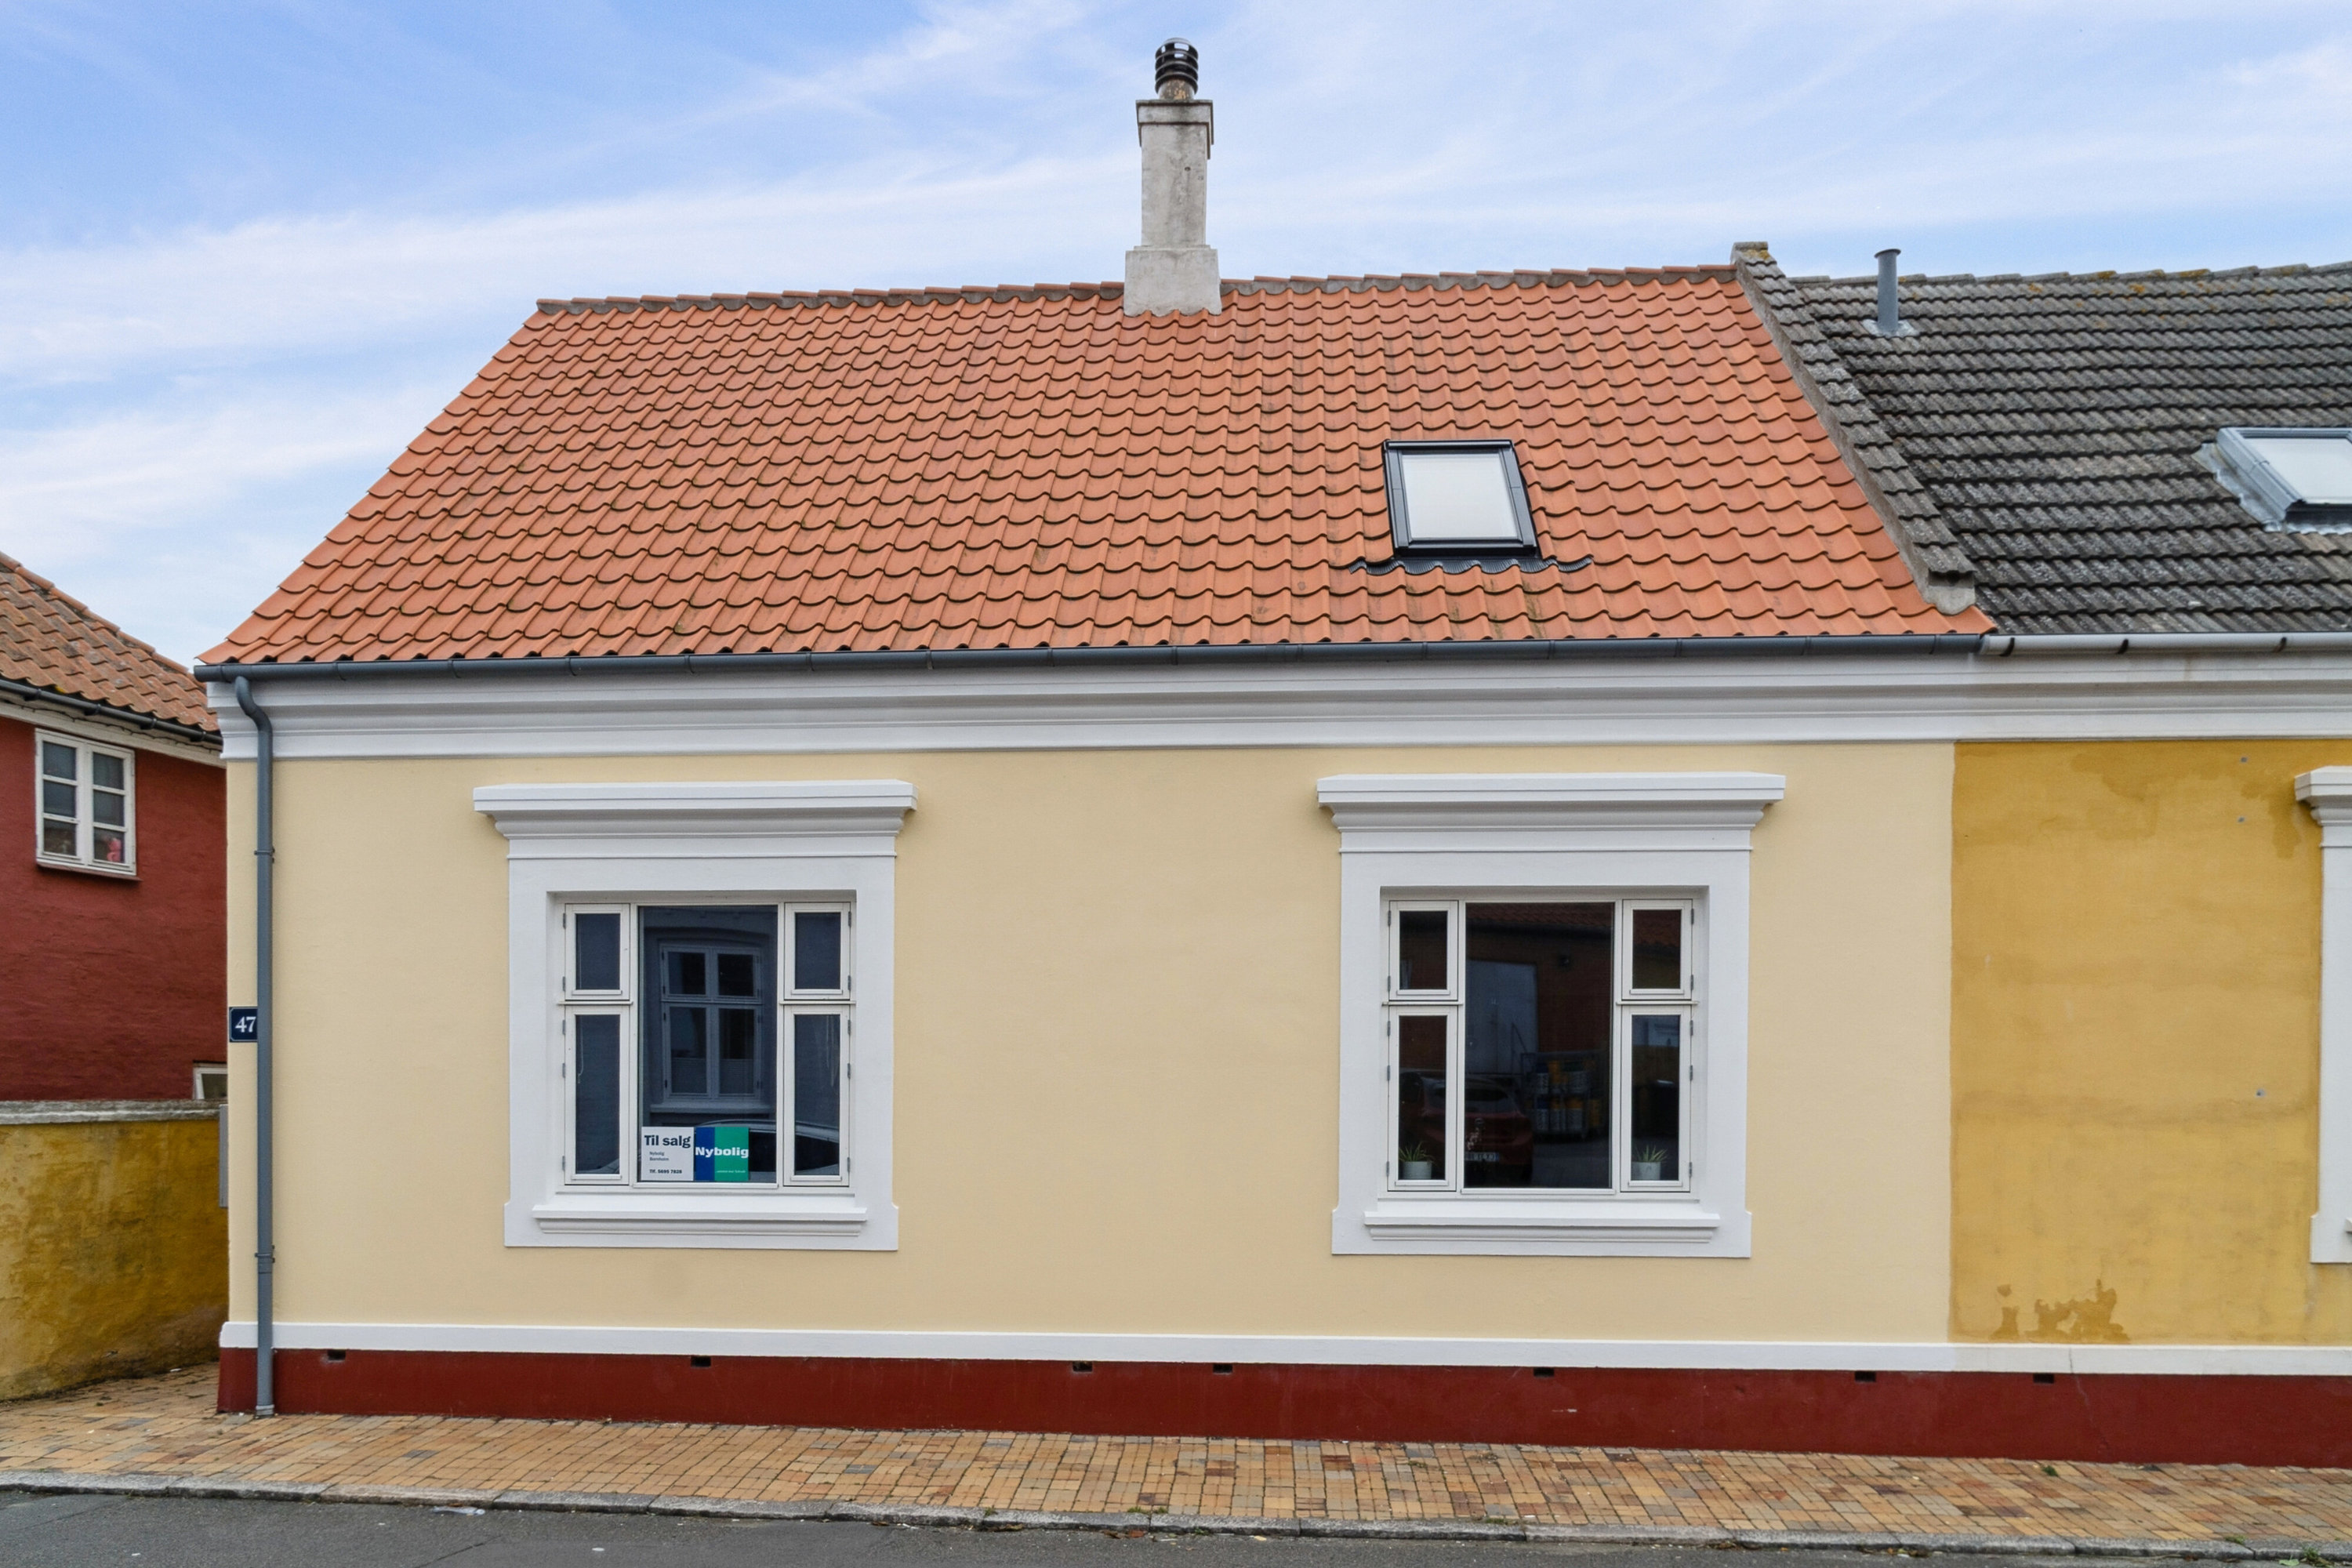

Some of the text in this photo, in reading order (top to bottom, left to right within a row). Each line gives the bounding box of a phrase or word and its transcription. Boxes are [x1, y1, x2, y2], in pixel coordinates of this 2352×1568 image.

[235, 1016, 256, 1033] 47
[644, 1134, 691, 1149] Til salg
[695, 1147, 749, 1158] Nybolig
